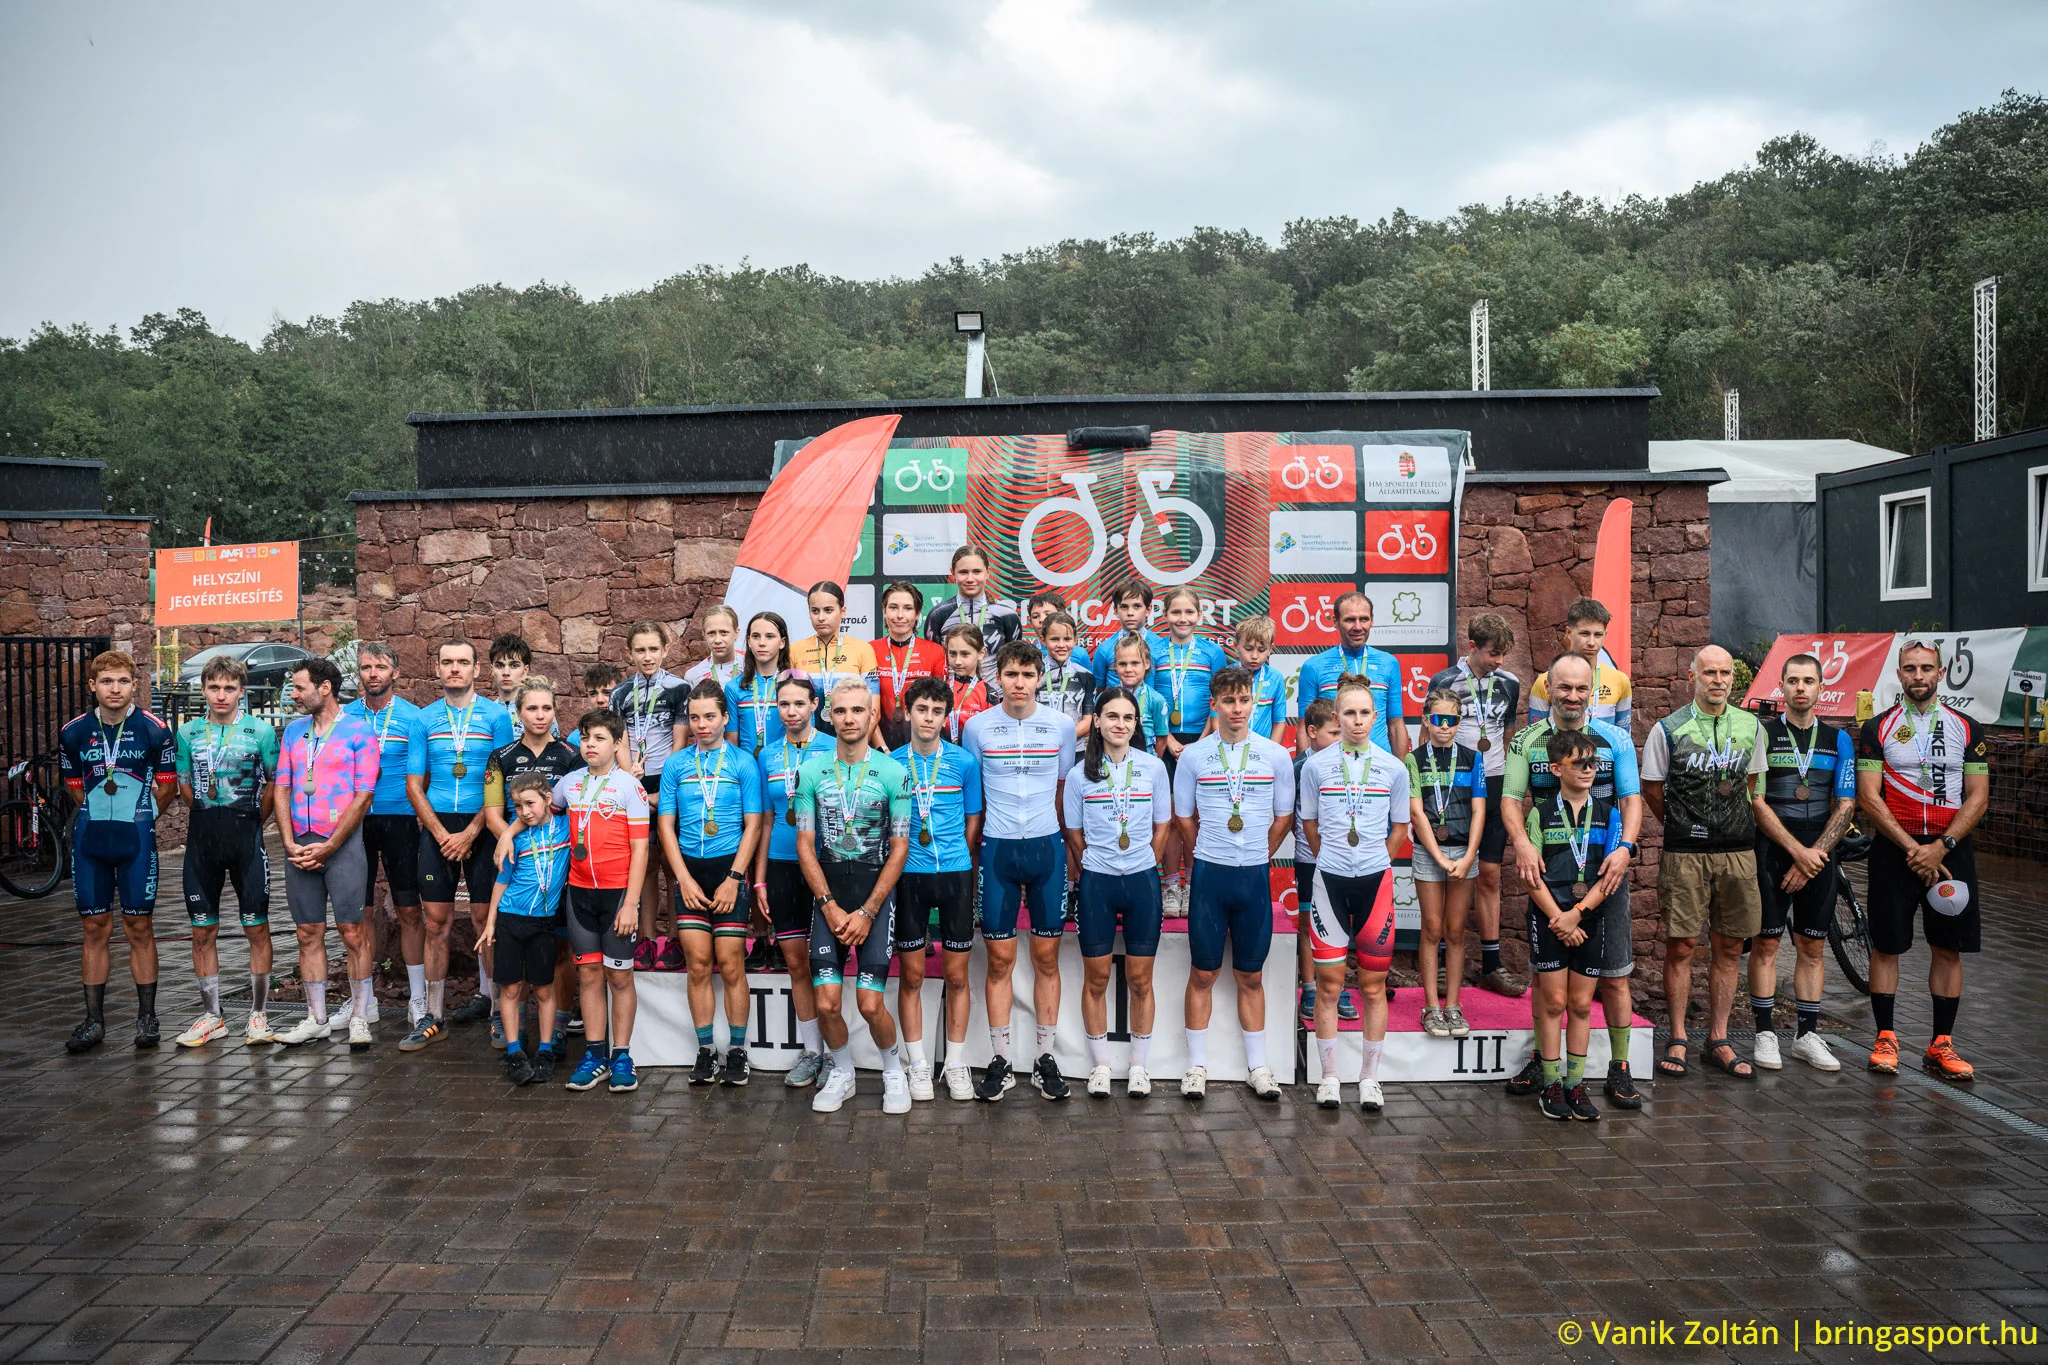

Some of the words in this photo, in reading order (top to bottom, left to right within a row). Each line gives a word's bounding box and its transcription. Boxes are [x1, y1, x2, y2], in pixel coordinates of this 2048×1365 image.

[192, 569, 261, 587] HELYSZÍNI
[168, 588, 283, 611] JEGYÉRTÉKESÍTÉS
[840, 615, 867, 624] RTOLÓ
[1932, 720, 1946, 757] BIKE
[200, 761, 209, 793] UNITED
[1844, 759, 1855, 789] ZKSE
[1932, 763, 1947, 806] ZONE
[827, 808, 838, 843] UNITED
[1310, 900, 1329, 938] ZONE
[1375, 911, 1393, 946] BIKE
[1453, 1036, 1507, 1074] III
